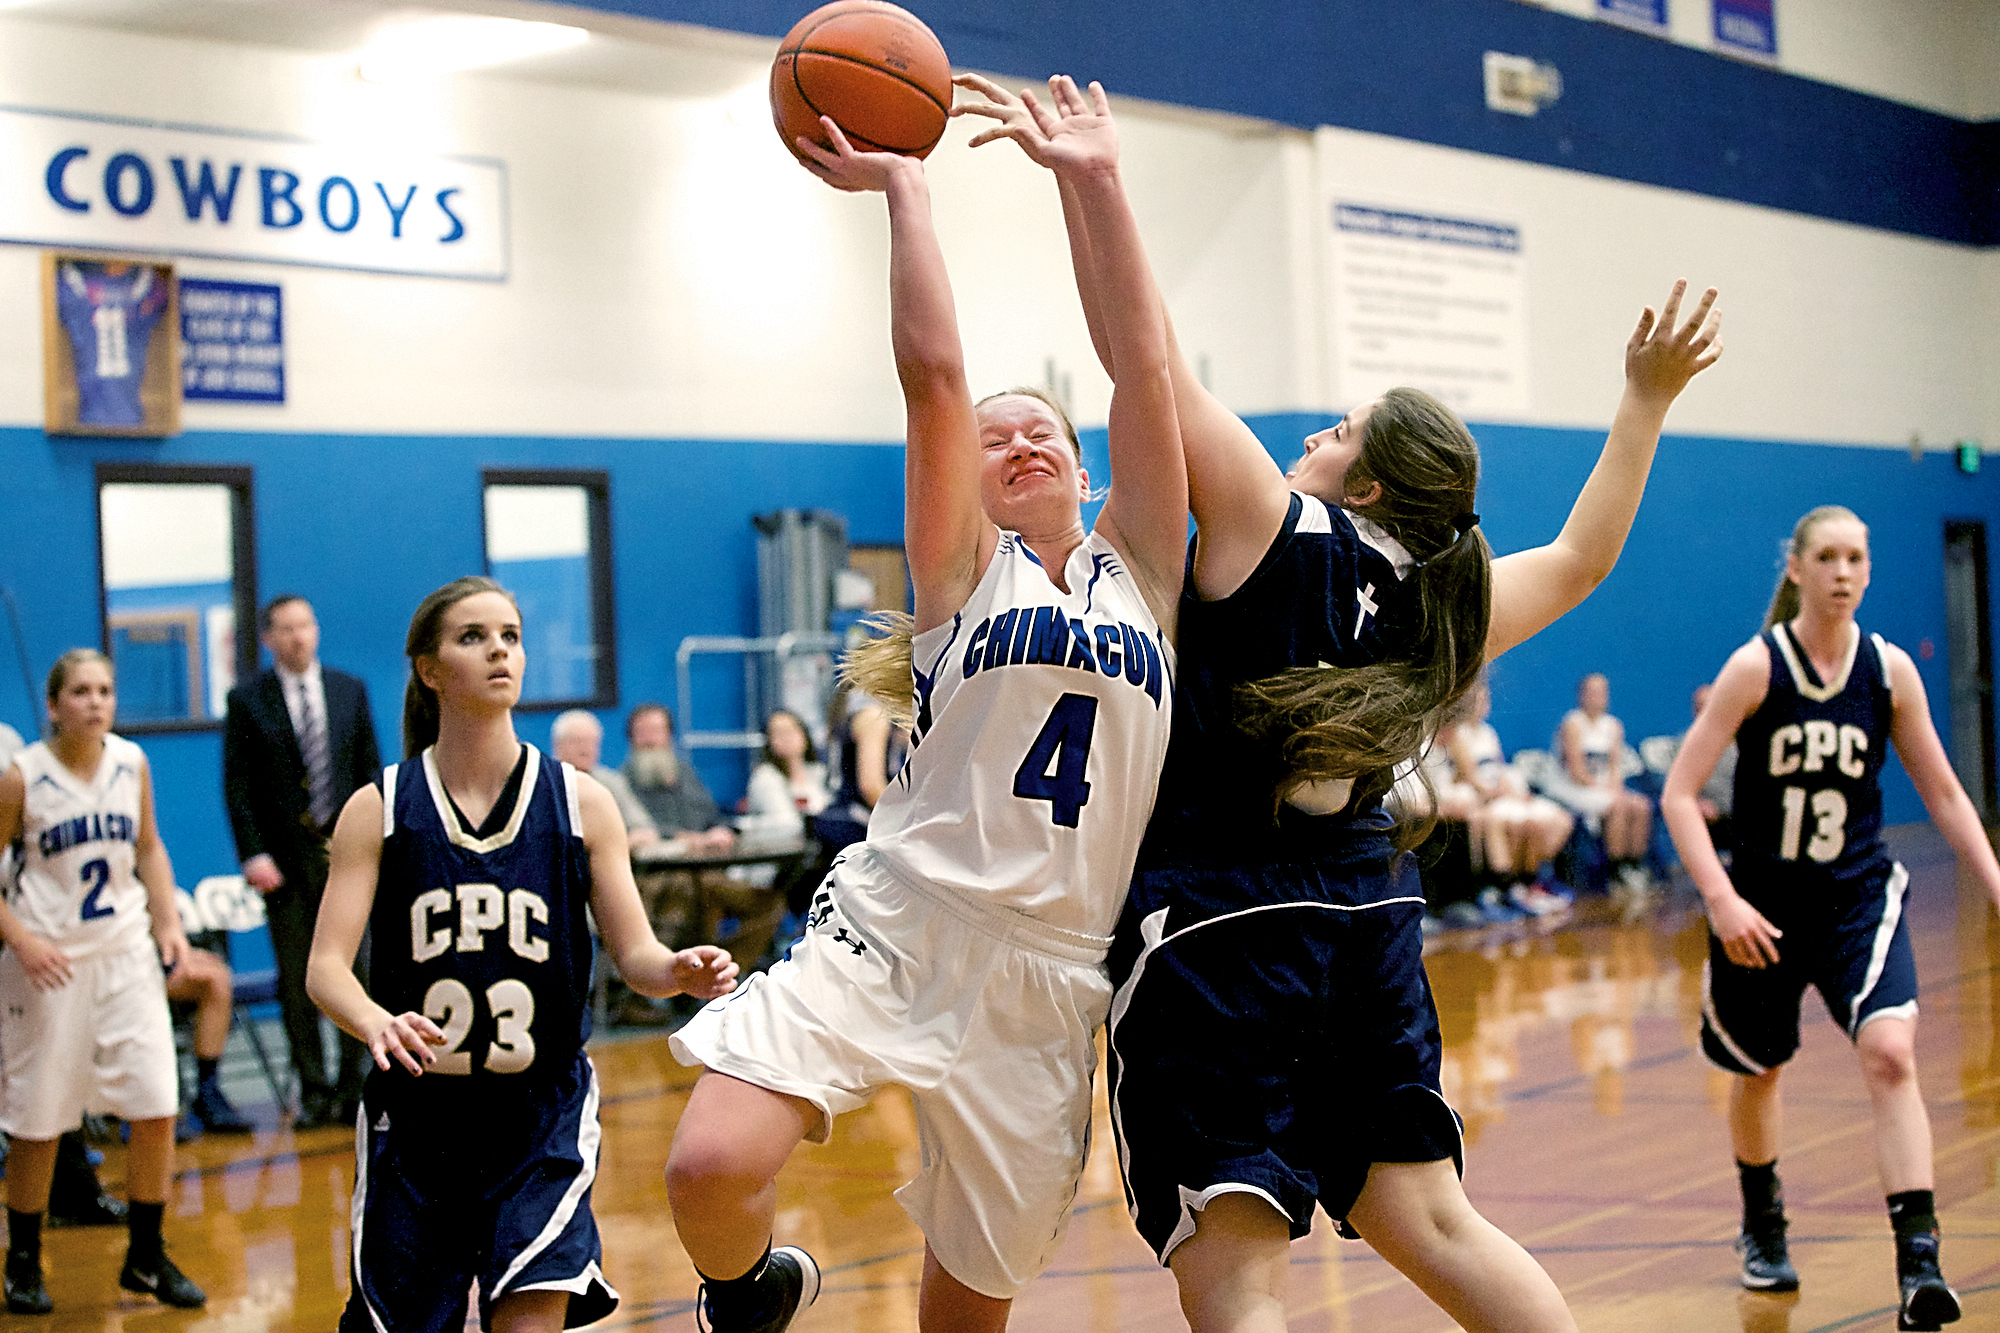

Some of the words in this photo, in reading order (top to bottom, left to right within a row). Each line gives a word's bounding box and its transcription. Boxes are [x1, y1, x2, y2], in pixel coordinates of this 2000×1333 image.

[45, 146, 466, 243] COWBOYS
[1012, 692, 1099, 829] 4
[1768, 719, 1869, 780] CPC
[39, 812, 136, 859] CHIMACU
[1780, 785, 1849, 864] 13
[81, 858, 115, 920] 2
[410, 883, 550, 963] CPC
[422, 978, 536, 1075] 23
